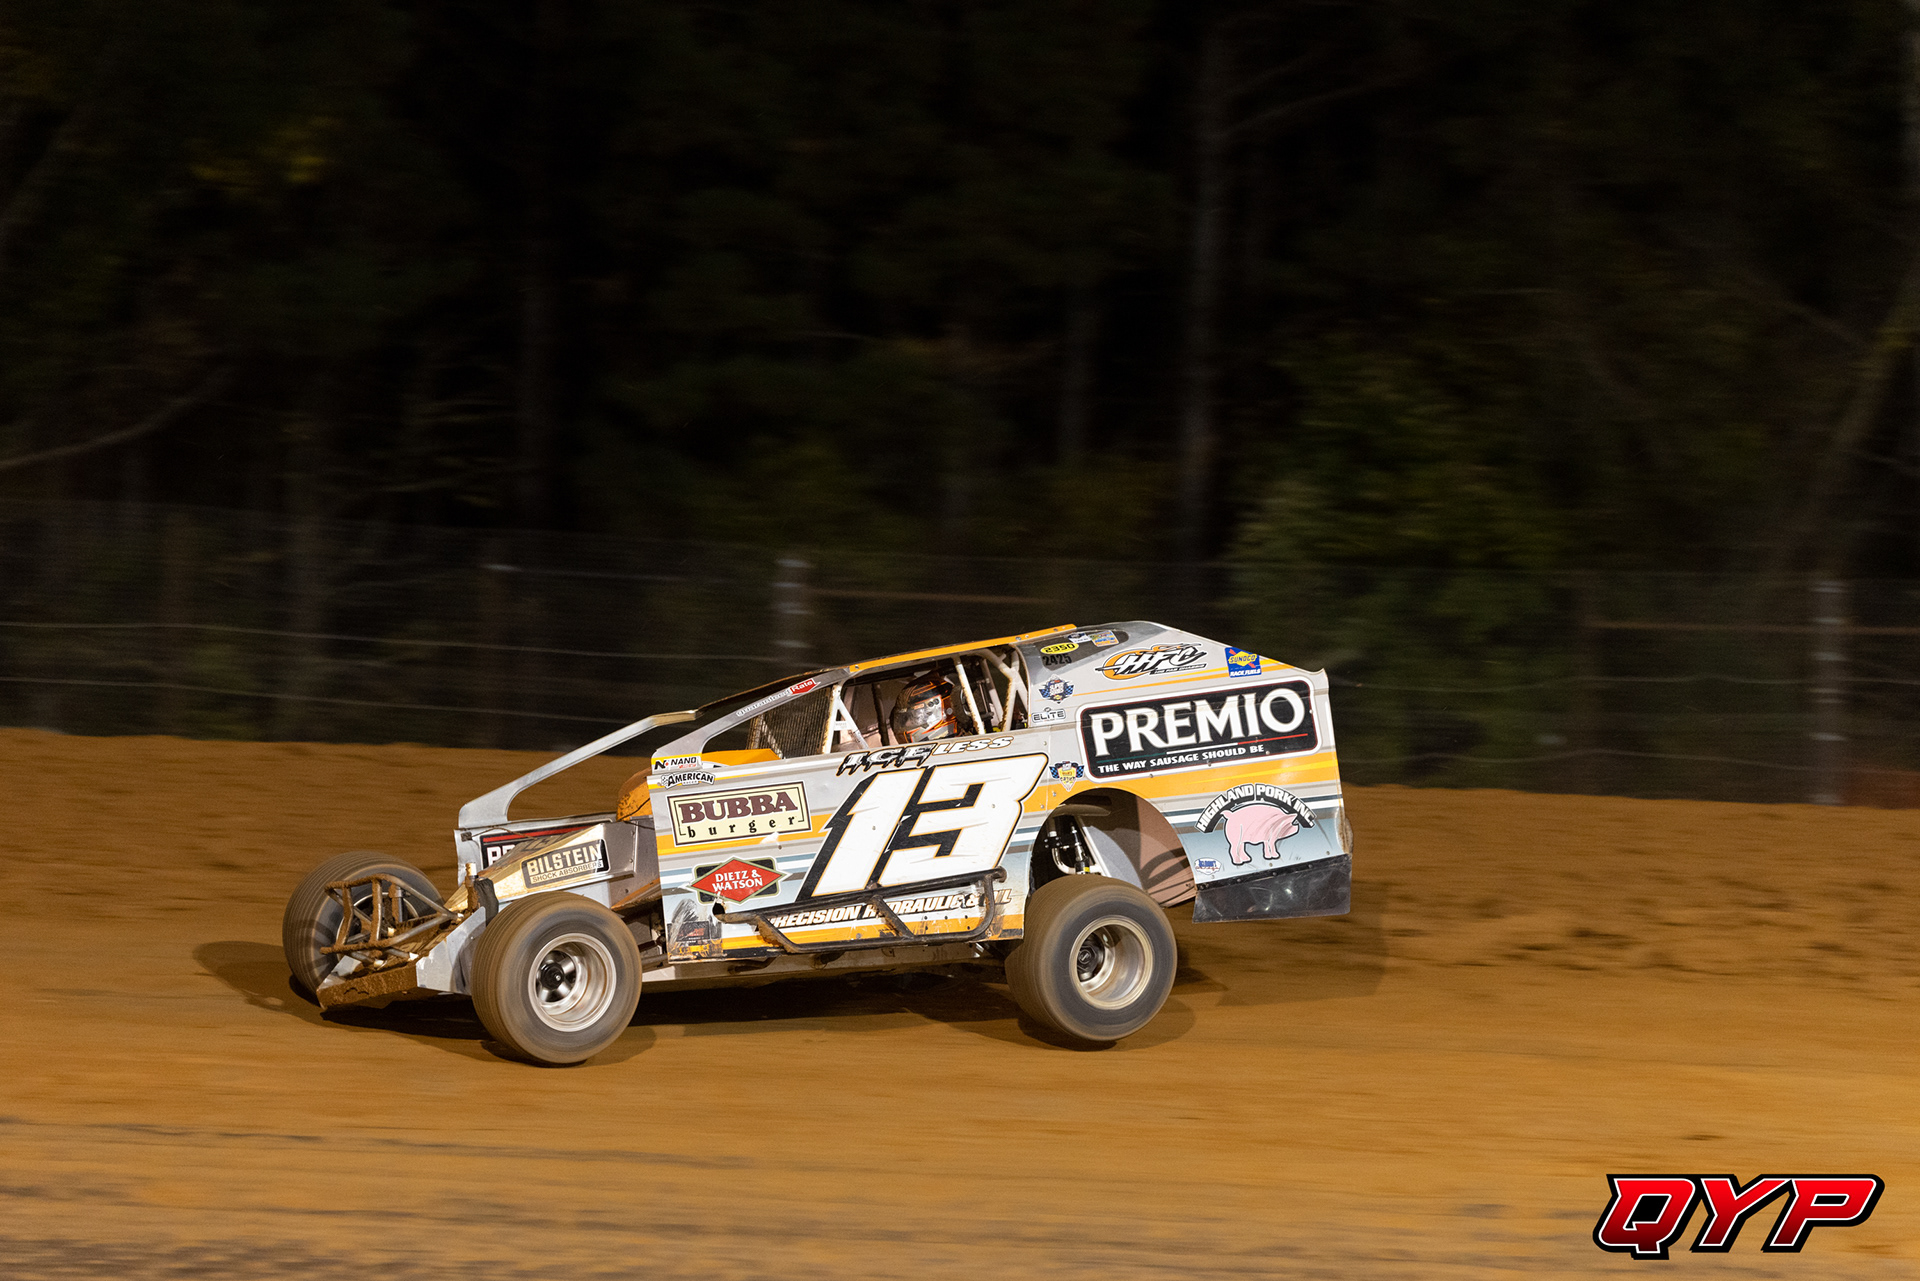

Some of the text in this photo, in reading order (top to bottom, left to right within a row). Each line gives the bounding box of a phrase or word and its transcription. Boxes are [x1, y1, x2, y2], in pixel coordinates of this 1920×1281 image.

[1044, 643, 1076, 653] 2350
[1042, 653, 1072, 666] 2425
[1230, 654, 1256, 663] SUNOCO
[792, 681, 814, 692] Rate
[1033, 710, 1065, 720] ELITE
[1089, 688, 1305, 756] PREMIO
[671, 757, 697, 766] NANO
[1098, 744, 1264, 774] THE WAY SAUSAGE SHOULD BE
[668, 773, 714, 786] AMERICAN
[678, 792, 798, 823] BUBBA
[1197, 785, 1315, 832] HIGHLAND PORK INC.
[687, 816, 795, 838] burger
[797, 753, 1048, 899] 13
[526, 843, 603, 876] BILSTEIN
[532, 861, 602, 883] SHOCK ABSORBERS
[715, 869, 762, 882] DIETZ &
[712, 878, 763, 892] WATSON
[862, 894, 964, 918] HDRAULIC
